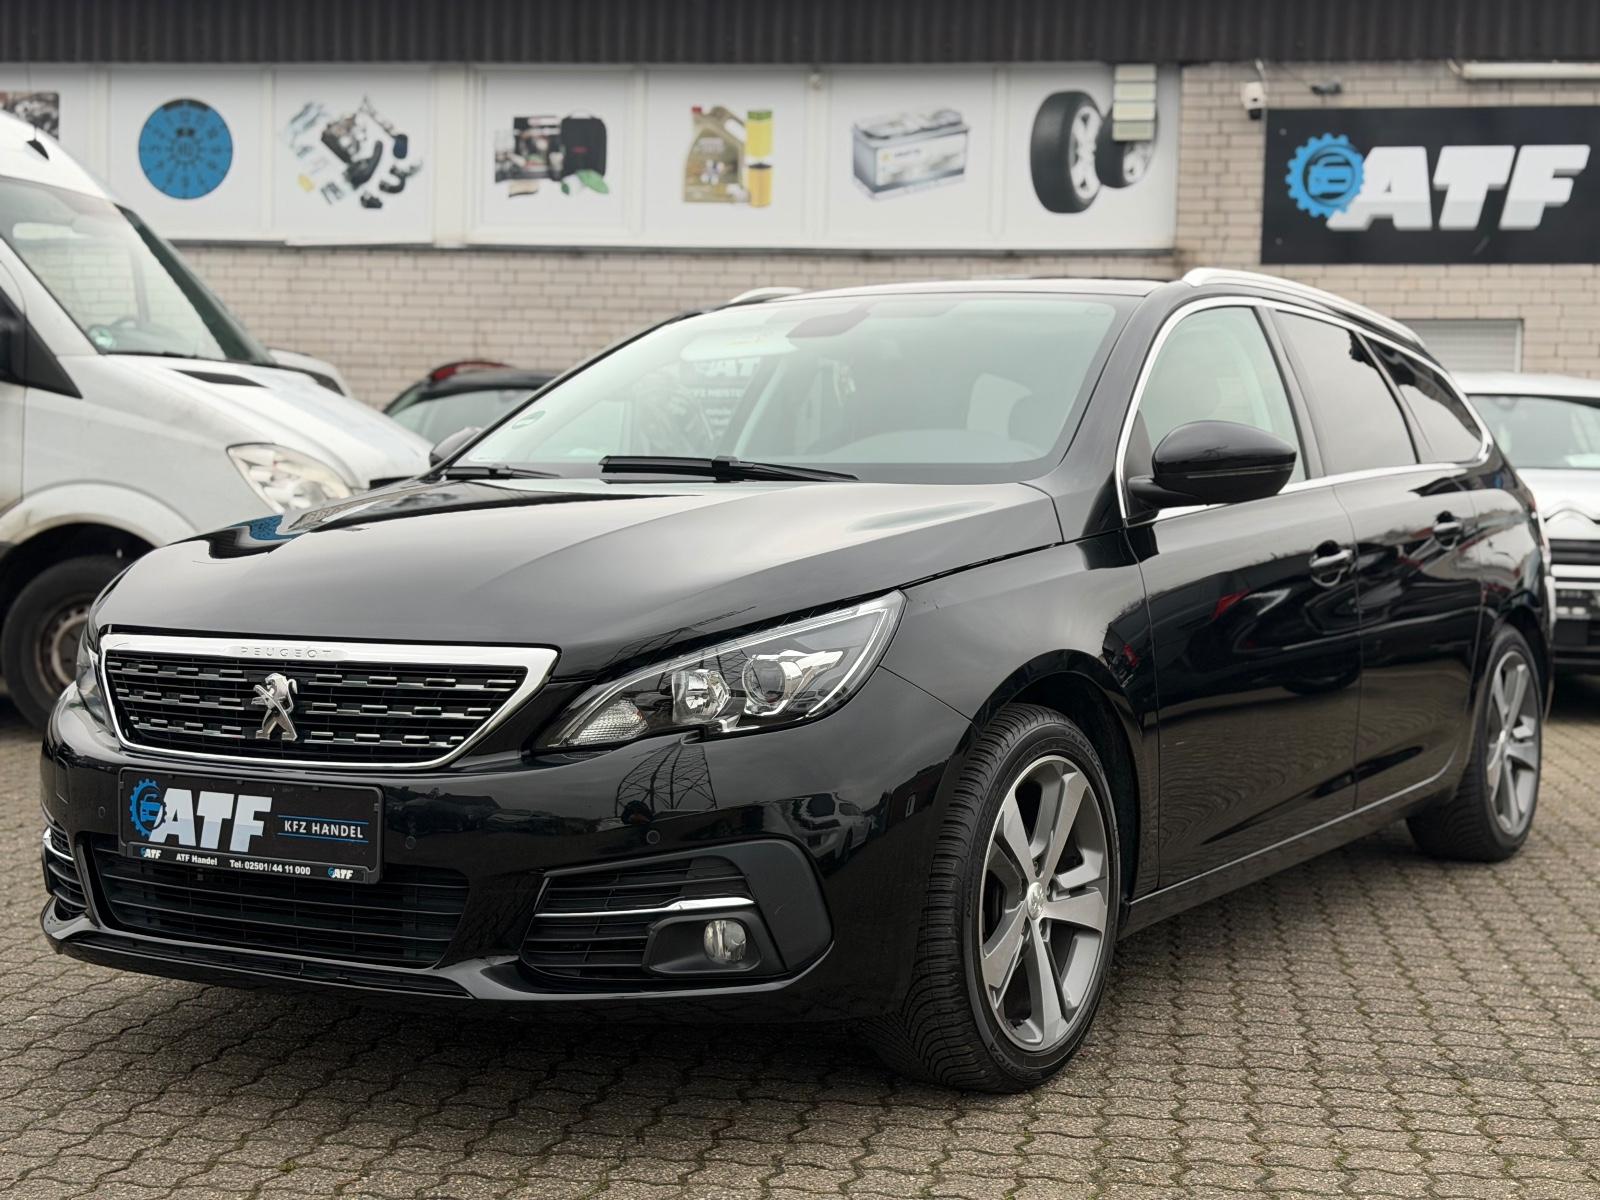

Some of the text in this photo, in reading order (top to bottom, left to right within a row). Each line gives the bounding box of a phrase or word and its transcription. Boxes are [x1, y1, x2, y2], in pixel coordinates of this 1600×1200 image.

[1326, 144, 1591, 231] ATF
[240, 646, 332, 658] PEUGEOT
[148, 787, 273, 852] ATF
[284, 819, 364, 839] KFZ HANDEL
[143, 848, 162, 860] ATF
[176, 852, 218, 866] ATF Handel
[284, 865, 296, 874] 11
[295, 866, 311, 875] 000
[332, 868, 354, 880] ATF
